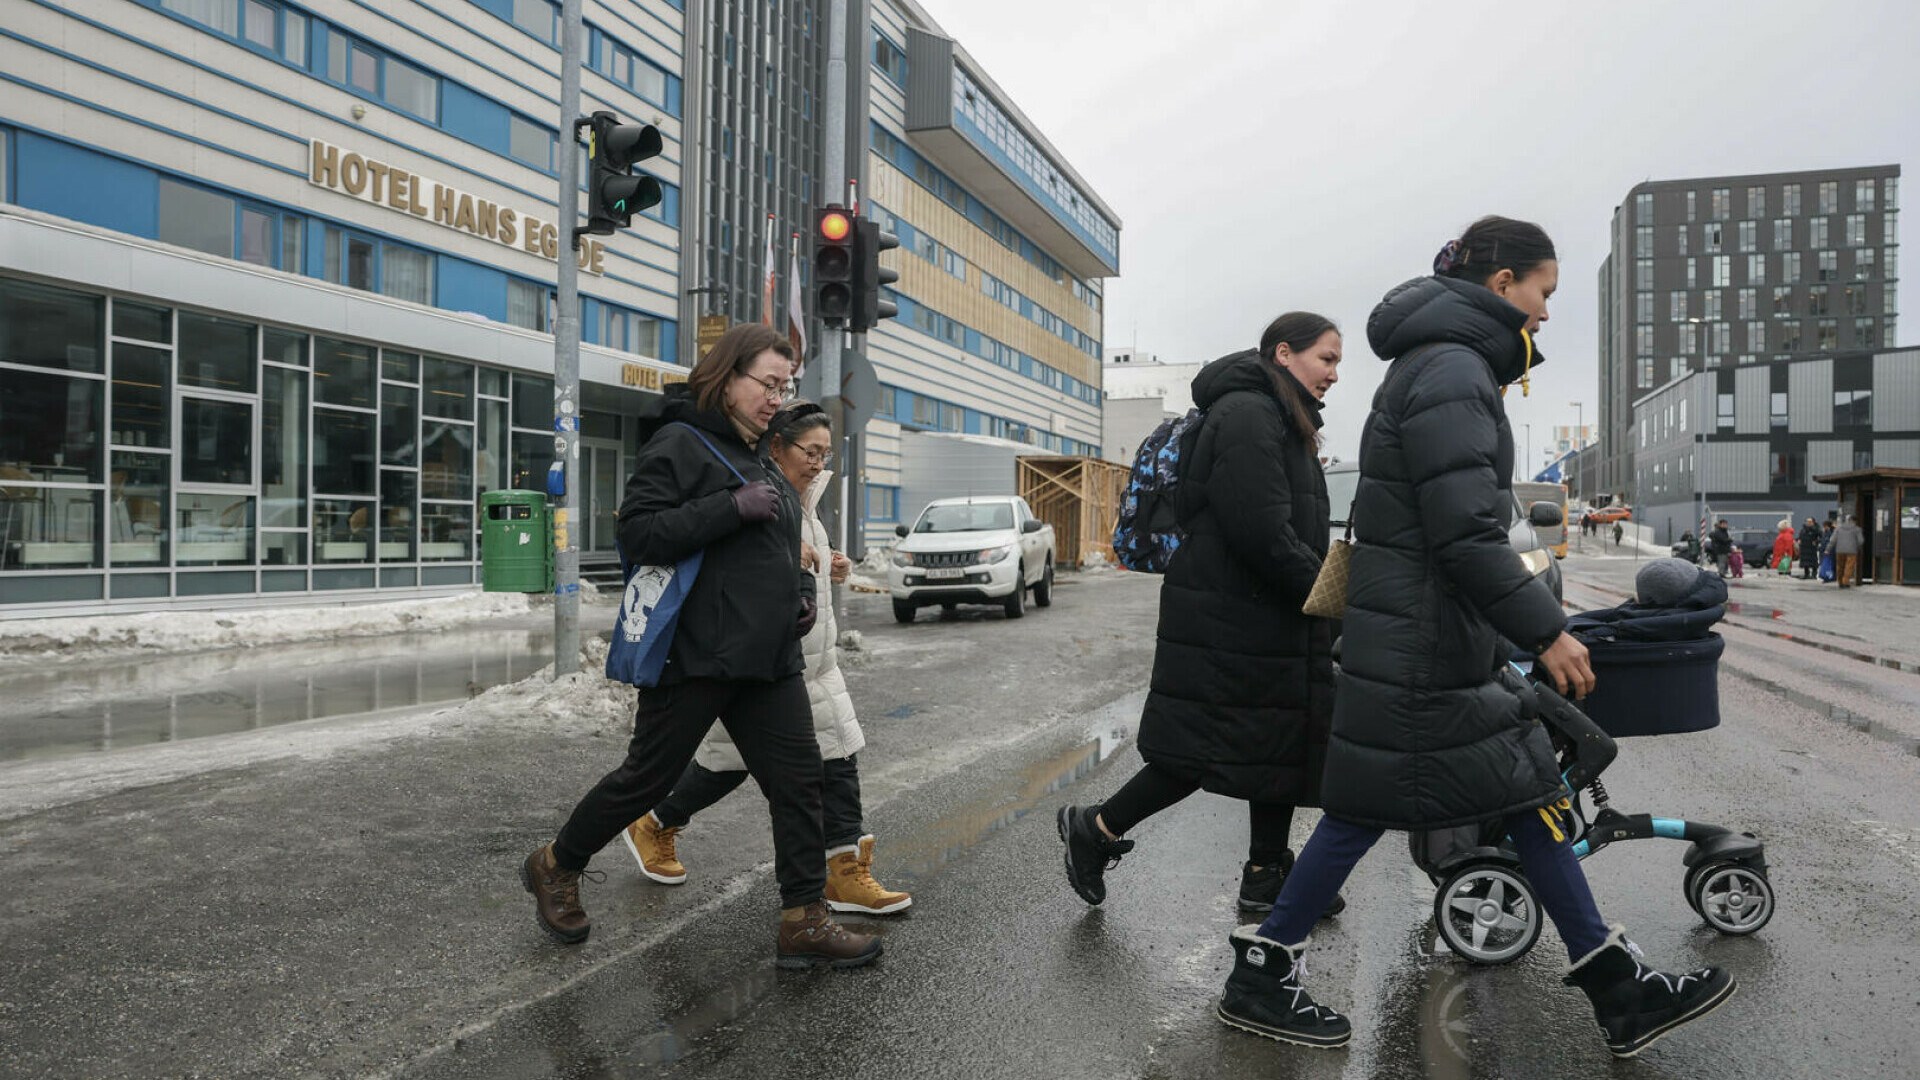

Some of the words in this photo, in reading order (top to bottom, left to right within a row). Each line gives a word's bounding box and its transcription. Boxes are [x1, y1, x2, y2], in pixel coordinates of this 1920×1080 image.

[313, 140, 428, 217] HOTEL
[434, 184, 516, 245] HANS
[524, 217, 604, 274] EGDE
[623, 362, 660, 390] HOTEL
